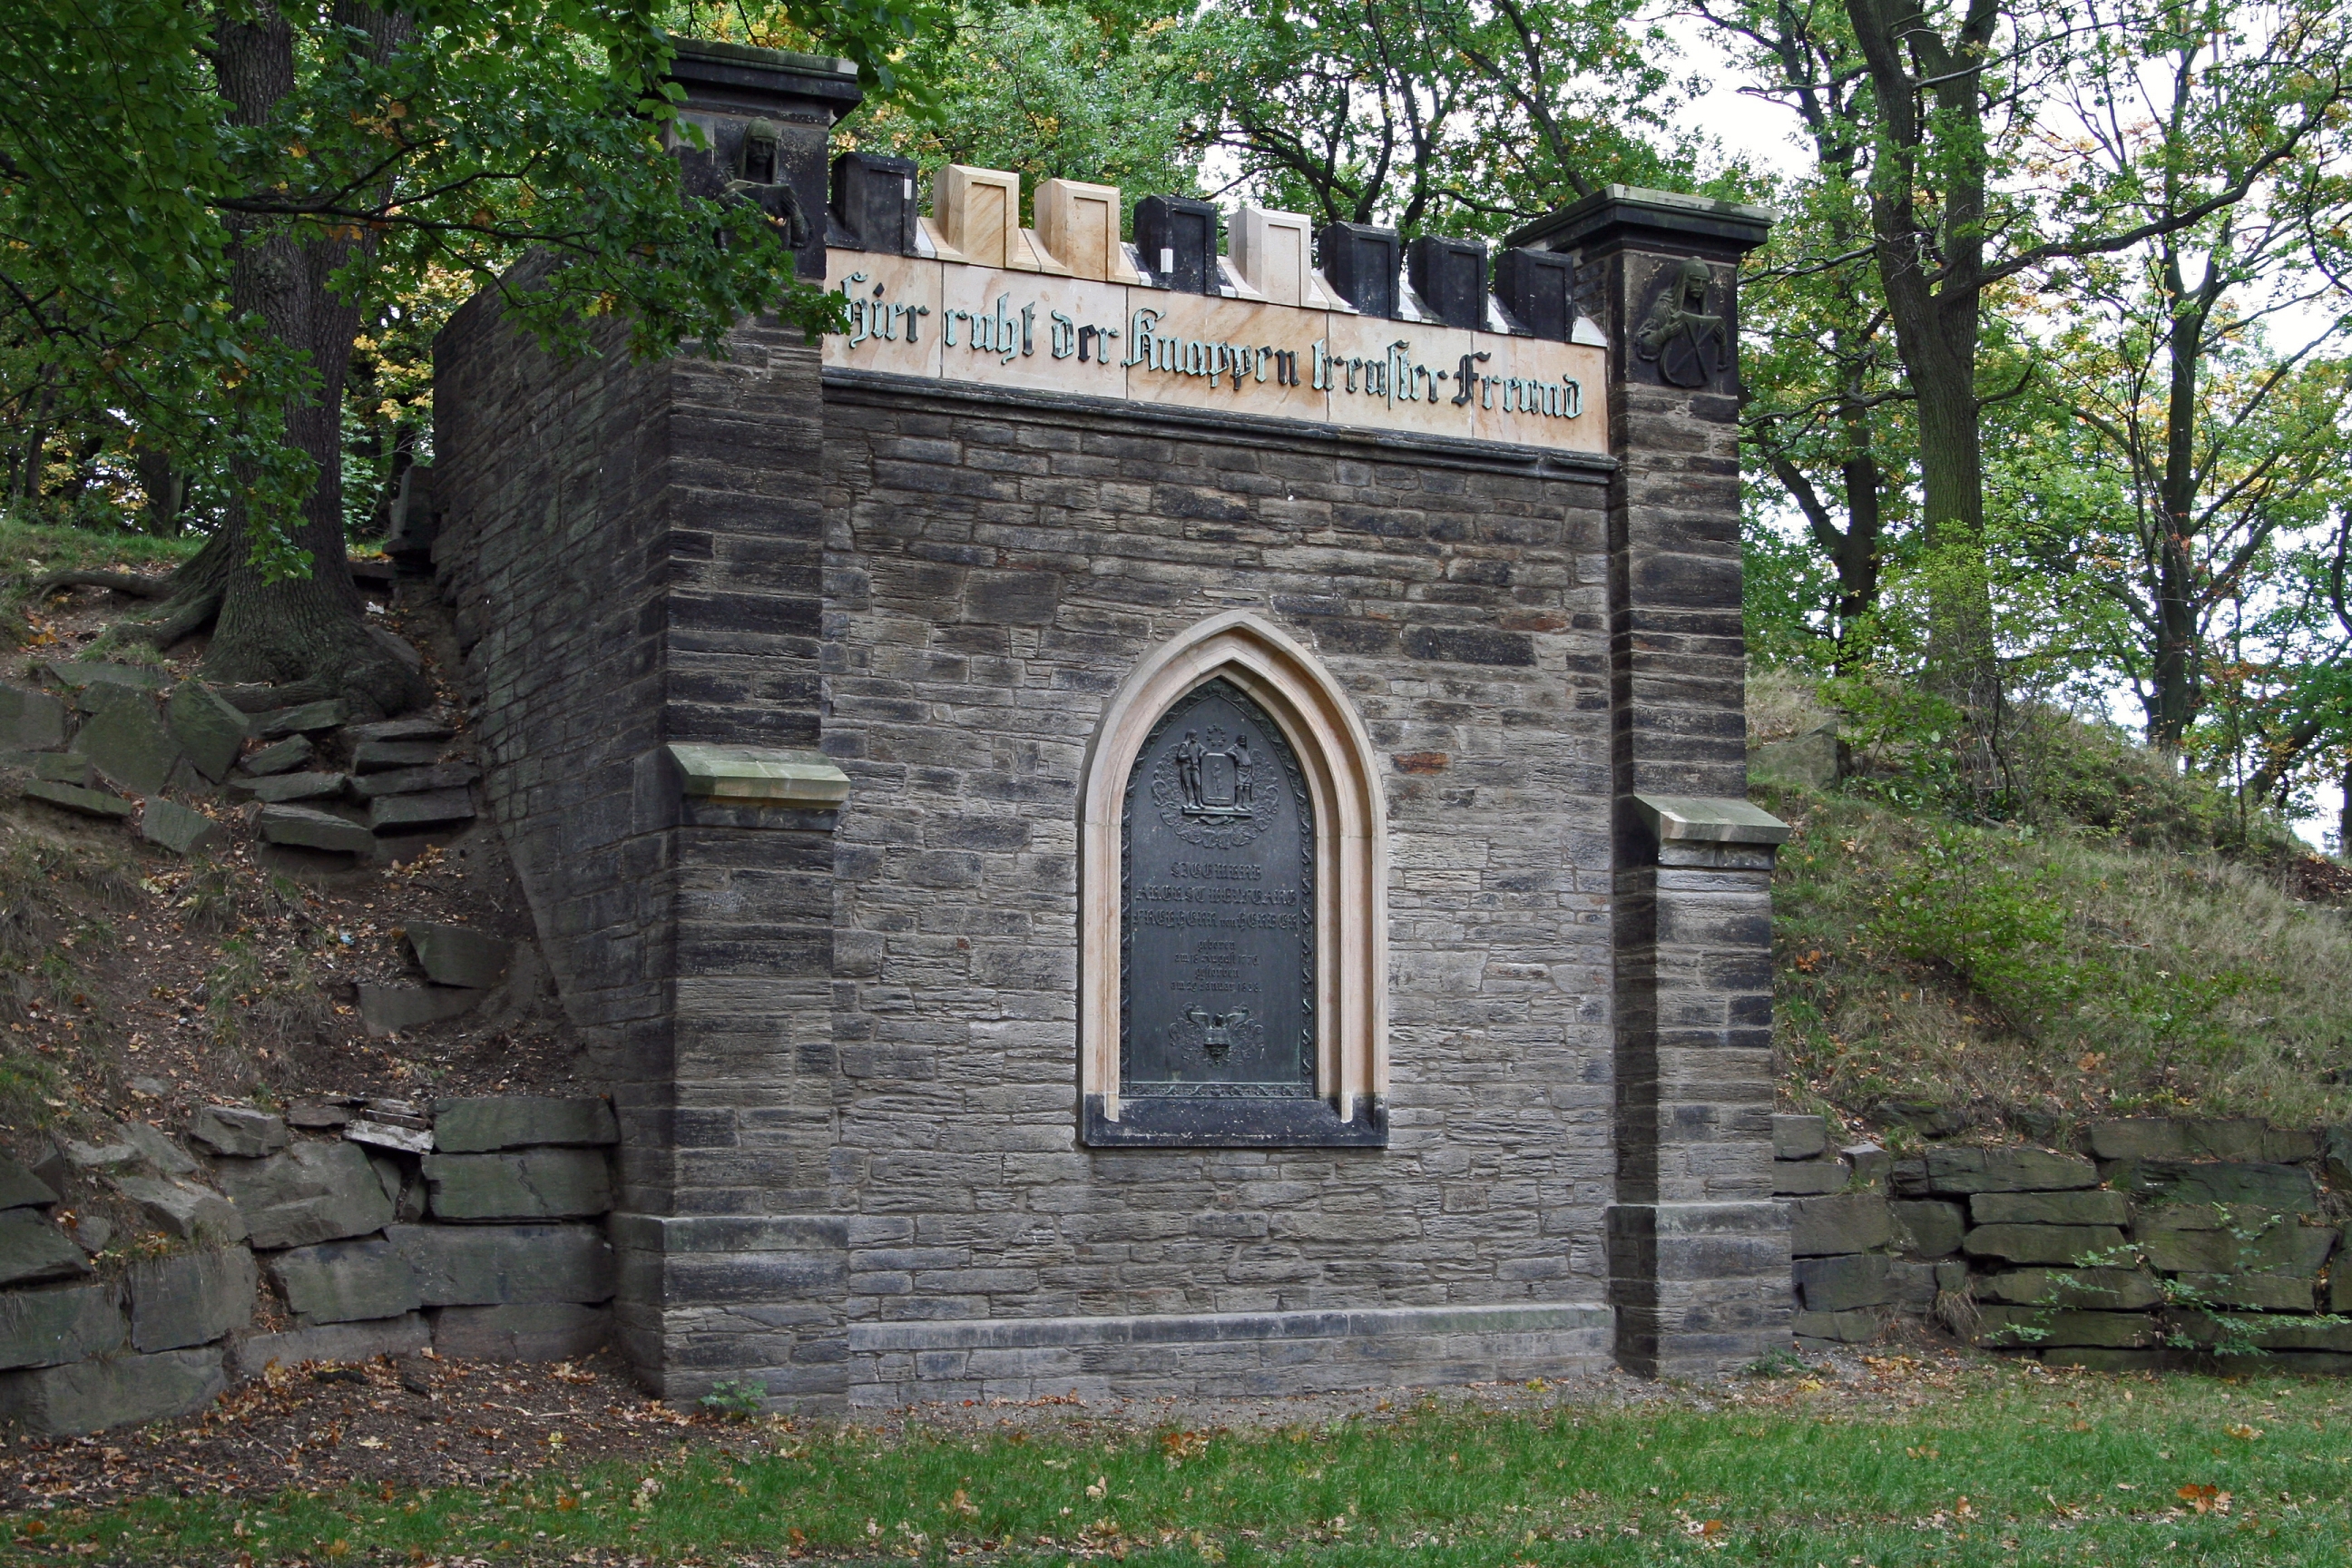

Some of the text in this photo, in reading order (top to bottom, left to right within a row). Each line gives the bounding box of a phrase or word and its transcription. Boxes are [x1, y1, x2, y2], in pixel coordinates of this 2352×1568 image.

[945, 292, 1035, 366] ruht
[1052, 309, 1121, 365] der
[1121, 308, 1300, 390] Knappen
[1452, 351, 1583, 419] Freund
